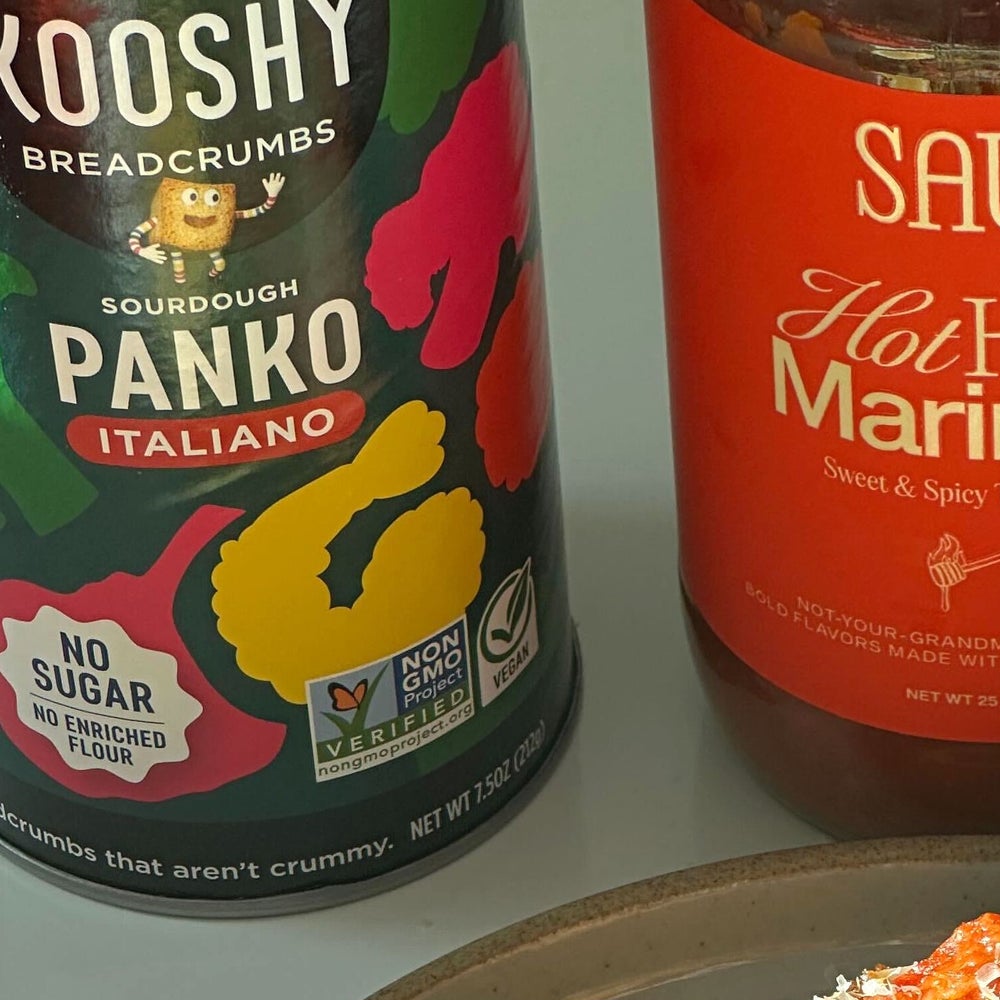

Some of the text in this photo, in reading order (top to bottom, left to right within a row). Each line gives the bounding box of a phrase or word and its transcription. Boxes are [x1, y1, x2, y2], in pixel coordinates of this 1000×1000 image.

[22, 119, 336, 177] BREADCRUMBS
[101, 279, 299, 315] SOURDOUGH
[776, 268, 962, 374] Hot
[49, 298, 362, 411] PANKO
[99, 408, 335, 458] ITALIANO
[824, 456, 889, 494] Sweet
[894, 475, 917, 498] &
[923, 478, 988, 509] Spicy
[745, 581, 788, 617] BOLD
[793, 611, 881, 653] FLAVORS
[889, 644, 951, 665] MADE
[60, 631, 110, 672] NO
[401, 628, 459, 675] NON
[402, 648, 462, 693] GMO
[493, 642, 530, 689] VEGAN
[32, 658, 155, 714] SUGAR
[404, 667, 463, 708] Project
[906, 688, 941, 703] NET
[945, 693, 973, 705] WT
[978, 695, 998, 707] 25
[33, 702, 167, 749] NO ENRICHED
[318, 704, 472, 777] nongmoproject.org
[326, 689, 465, 757] VERIFIED
[68, 735, 133, 766] FLOUR
[410, 808, 442, 840] NET
[446, 790, 471, 821] WT
[474, 758, 511, 804] 7.5OZ
[105, 850, 163, 876] that
[173, 862, 260, 880] aren't
[270, 837, 394, 877] crummy.
